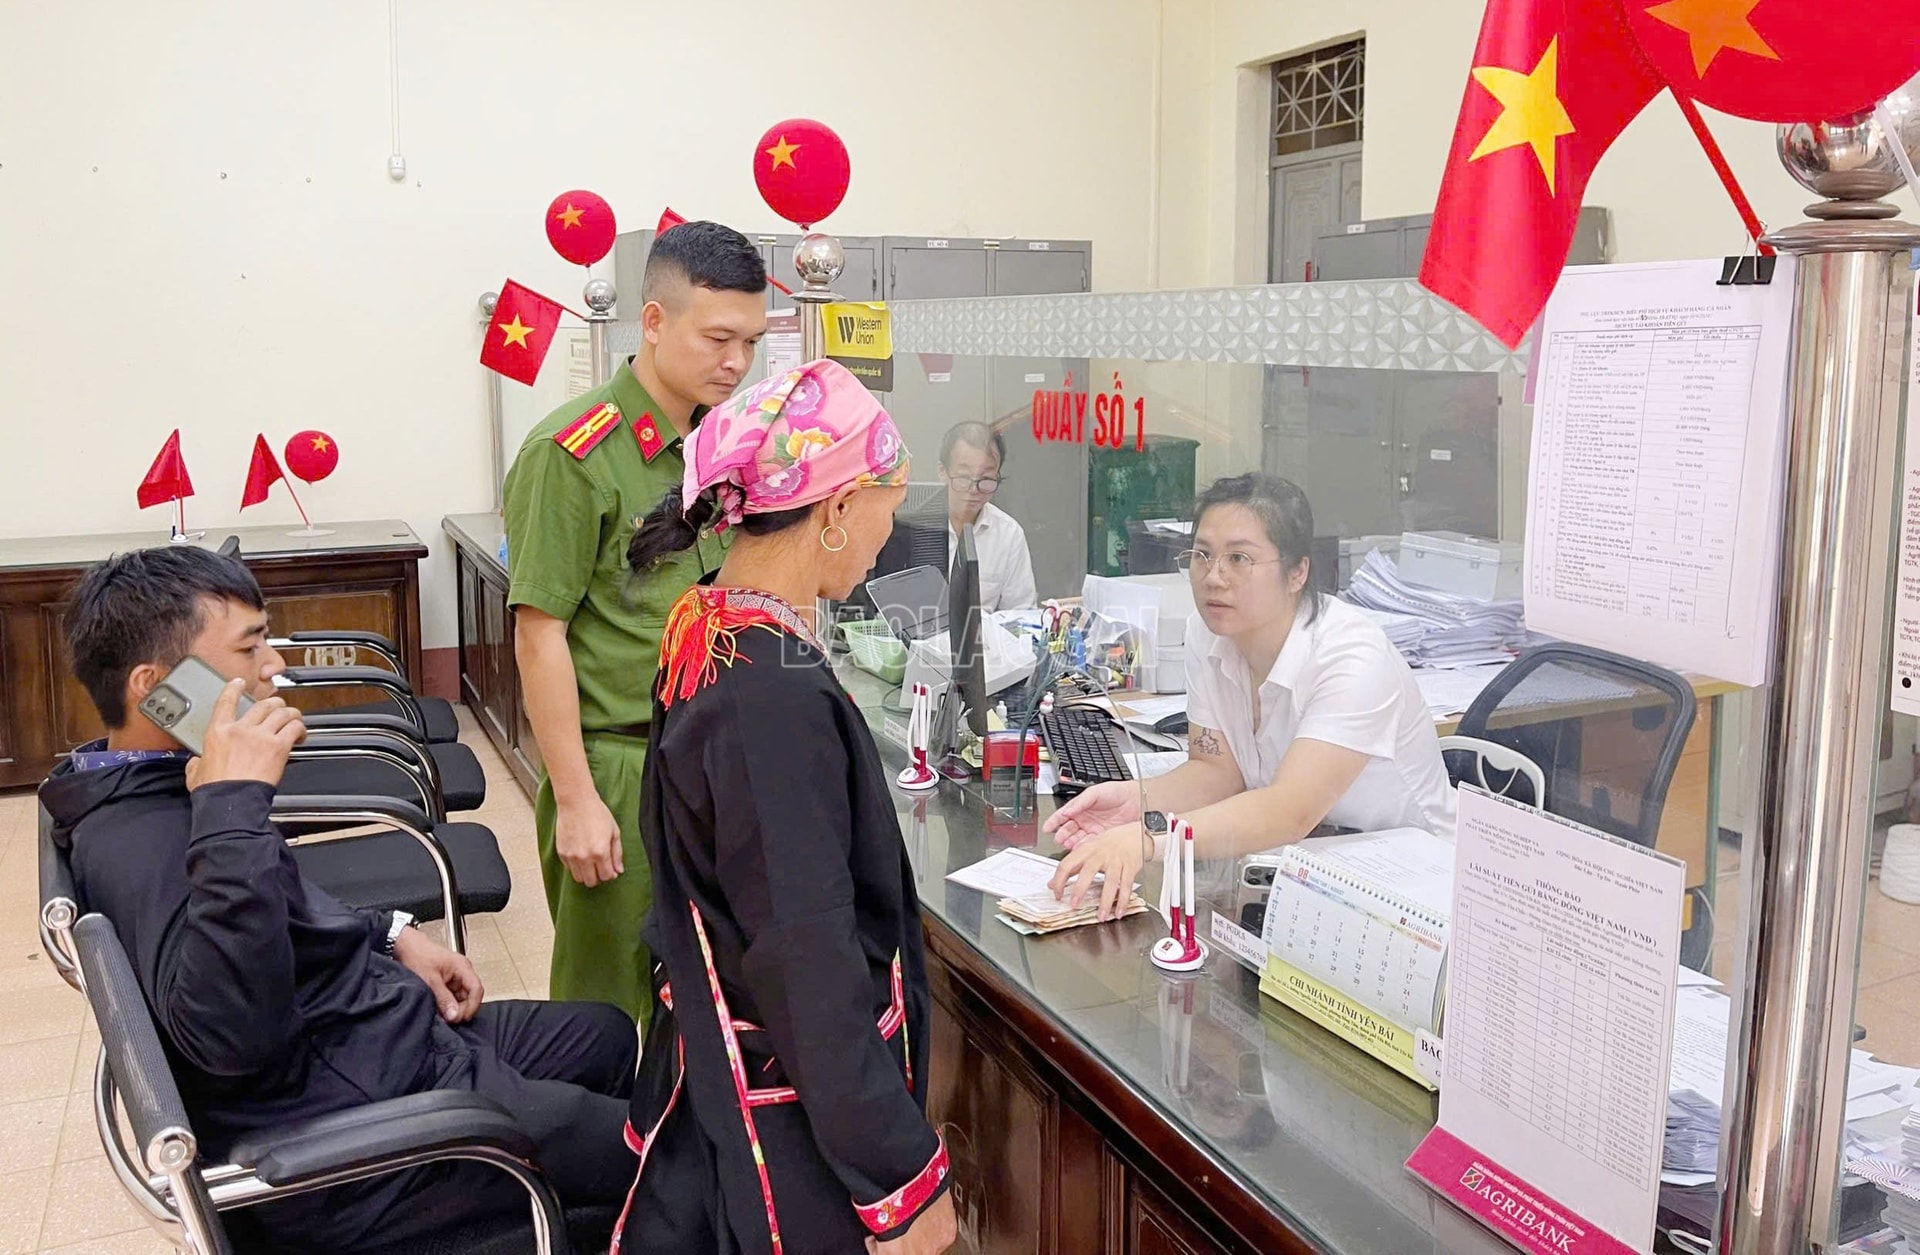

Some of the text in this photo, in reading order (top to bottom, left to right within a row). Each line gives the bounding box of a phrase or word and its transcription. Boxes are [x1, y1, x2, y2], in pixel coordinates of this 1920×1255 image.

[856, 316, 882, 331] Western
[856, 331, 874, 345] Union
[1094, 371, 1125, 450] SỐ
[1133, 396, 1144, 453] 1
[1298, 867, 1309, 880] 08
[1536, 879, 1581, 903] THÔNG BÁO
[1483, 866, 1501, 880] SUẤT
[1503, 876, 1520, 888] TIỀN
[1560, 900, 1583, 915] ĐỒNG
[1586, 910, 1604, 924] VIỆT
[1608, 919, 1626, 934] NAM
[1633, 930, 1652, 944] VND
[1406, 922, 1443, 944] AGRIBANK
[1290, 975, 1304, 989] CHI
[1306, 984, 1335, 1007] NHÁNH
[1337, 1001, 1357, 1018] TỈNH
[1359, 1014, 1377, 1031] YÊN
[1378, 1025, 1395, 1041] BÁI
[1476, 1184, 1576, 1254] AGRIBANK
